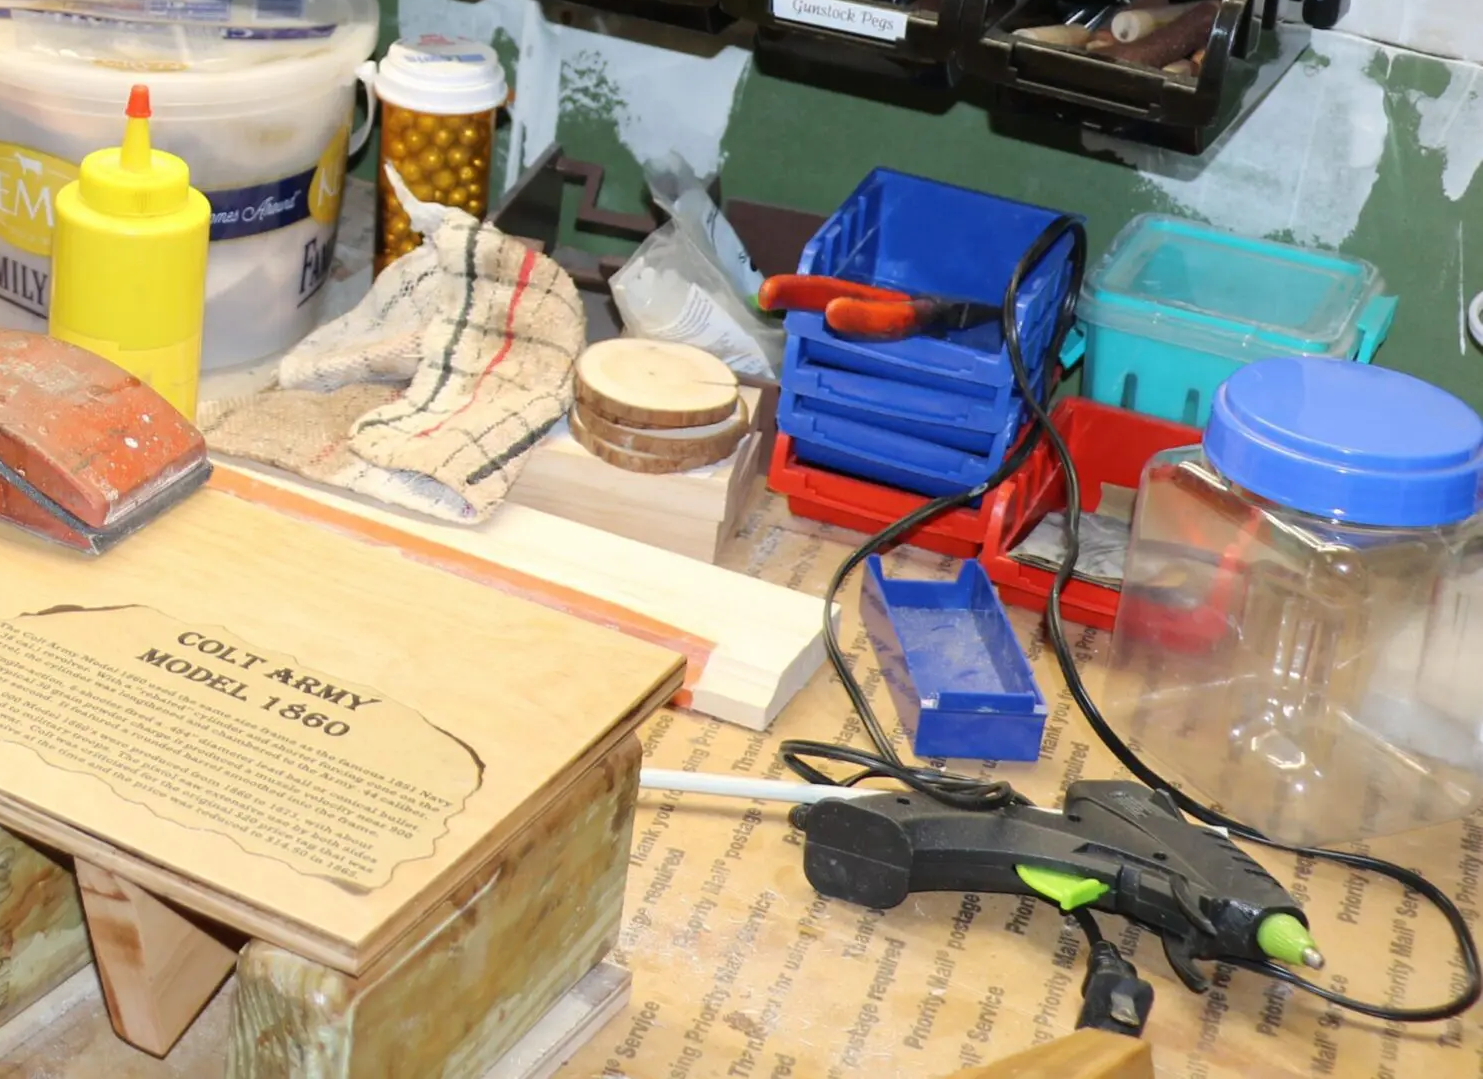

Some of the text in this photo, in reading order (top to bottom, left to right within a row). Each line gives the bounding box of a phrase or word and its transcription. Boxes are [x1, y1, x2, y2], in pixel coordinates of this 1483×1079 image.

[861, 8, 894, 32] Pegs
[209, 191, 297, 228] omes Around
[136, 646, 351, 740] MODEL 1860
[176, 630, 382, 714] COLT ARMY
[20, 631, 49, 644] Colt
[44, 641, 81, 658] Army
[79, 655, 120, 673] Model
[119, 670, 149, 684] 1860
[146, 681, 179, 696] used
[176, 693, 200, 705] the
[197, 703, 231, 718] same
[231, 716, 259, 729] size
[258, 726, 299, 745] frame
[297, 743, 315, 752] as
[313, 748, 338, 761] the
[335, 757, 388, 781] famous
[386, 777, 418, 793] 1851
[416, 790, 454, 808] Navy
[21, 651, 44, 663] the
[40, 660, 94, 683] cylinder
[91, 681, 118, 693] was
[114, 690, 187, 721] lengthened
[185, 718, 212, 731] and
[209, 727, 283, 760] chambered
[280, 757, 297, 765] to
[294, 762, 320, 775] the
[316, 771, 357, 790] Army
[377, 795, 431, 820] caliber.
[39, 649, 94, 673] revolver.
[93, 670, 126, 686] With
[132, 686, 196, 714] "rebated"
[190, 710, 246, 735] cylinder
[244, 731, 272, 745] and
[269, 741, 319, 764] shorter
[315, 760, 366, 784] forcing
[364, 780, 399, 796] cone
[397, 793, 417, 804] on
[416, 800, 442, 814] the
[1049, 702, 1071, 725] you
[66, 684, 125, 710] 6-shooter
[122, 706, 156, 722] fired
[196, 737, 256, 764] diameter
[254, 760, 286, 776] lead
[283, 772, 313, 787] ball
[310, 784, 328, 793] or
[327, 790, 380, 814] conical
[376, 810, 424, 832] bullet.
[731, 732, 765, 772] Thank
[629, 803, 676, 869] Thank you
[725, 807, 764, 861] postage
[645, 848, 685, 906] required
[1336, 867, 1370, 925] Priority
[1455, 857, 1483, 908] Priority
[843, 912, 878, 961] Thank
[868, 938, 906, 1003] required
[903, 985, 945, 1050] Priority
[947, 892, 982, 951] postage
[1036, 968, 1072, 1027] Priority
[620, 1000, 660, 1059] Service
[693, 978, 729, 1042] Priority
[975, 985, 1005, 1042] Service
[1257, 972, 1294, 1038] Priority
